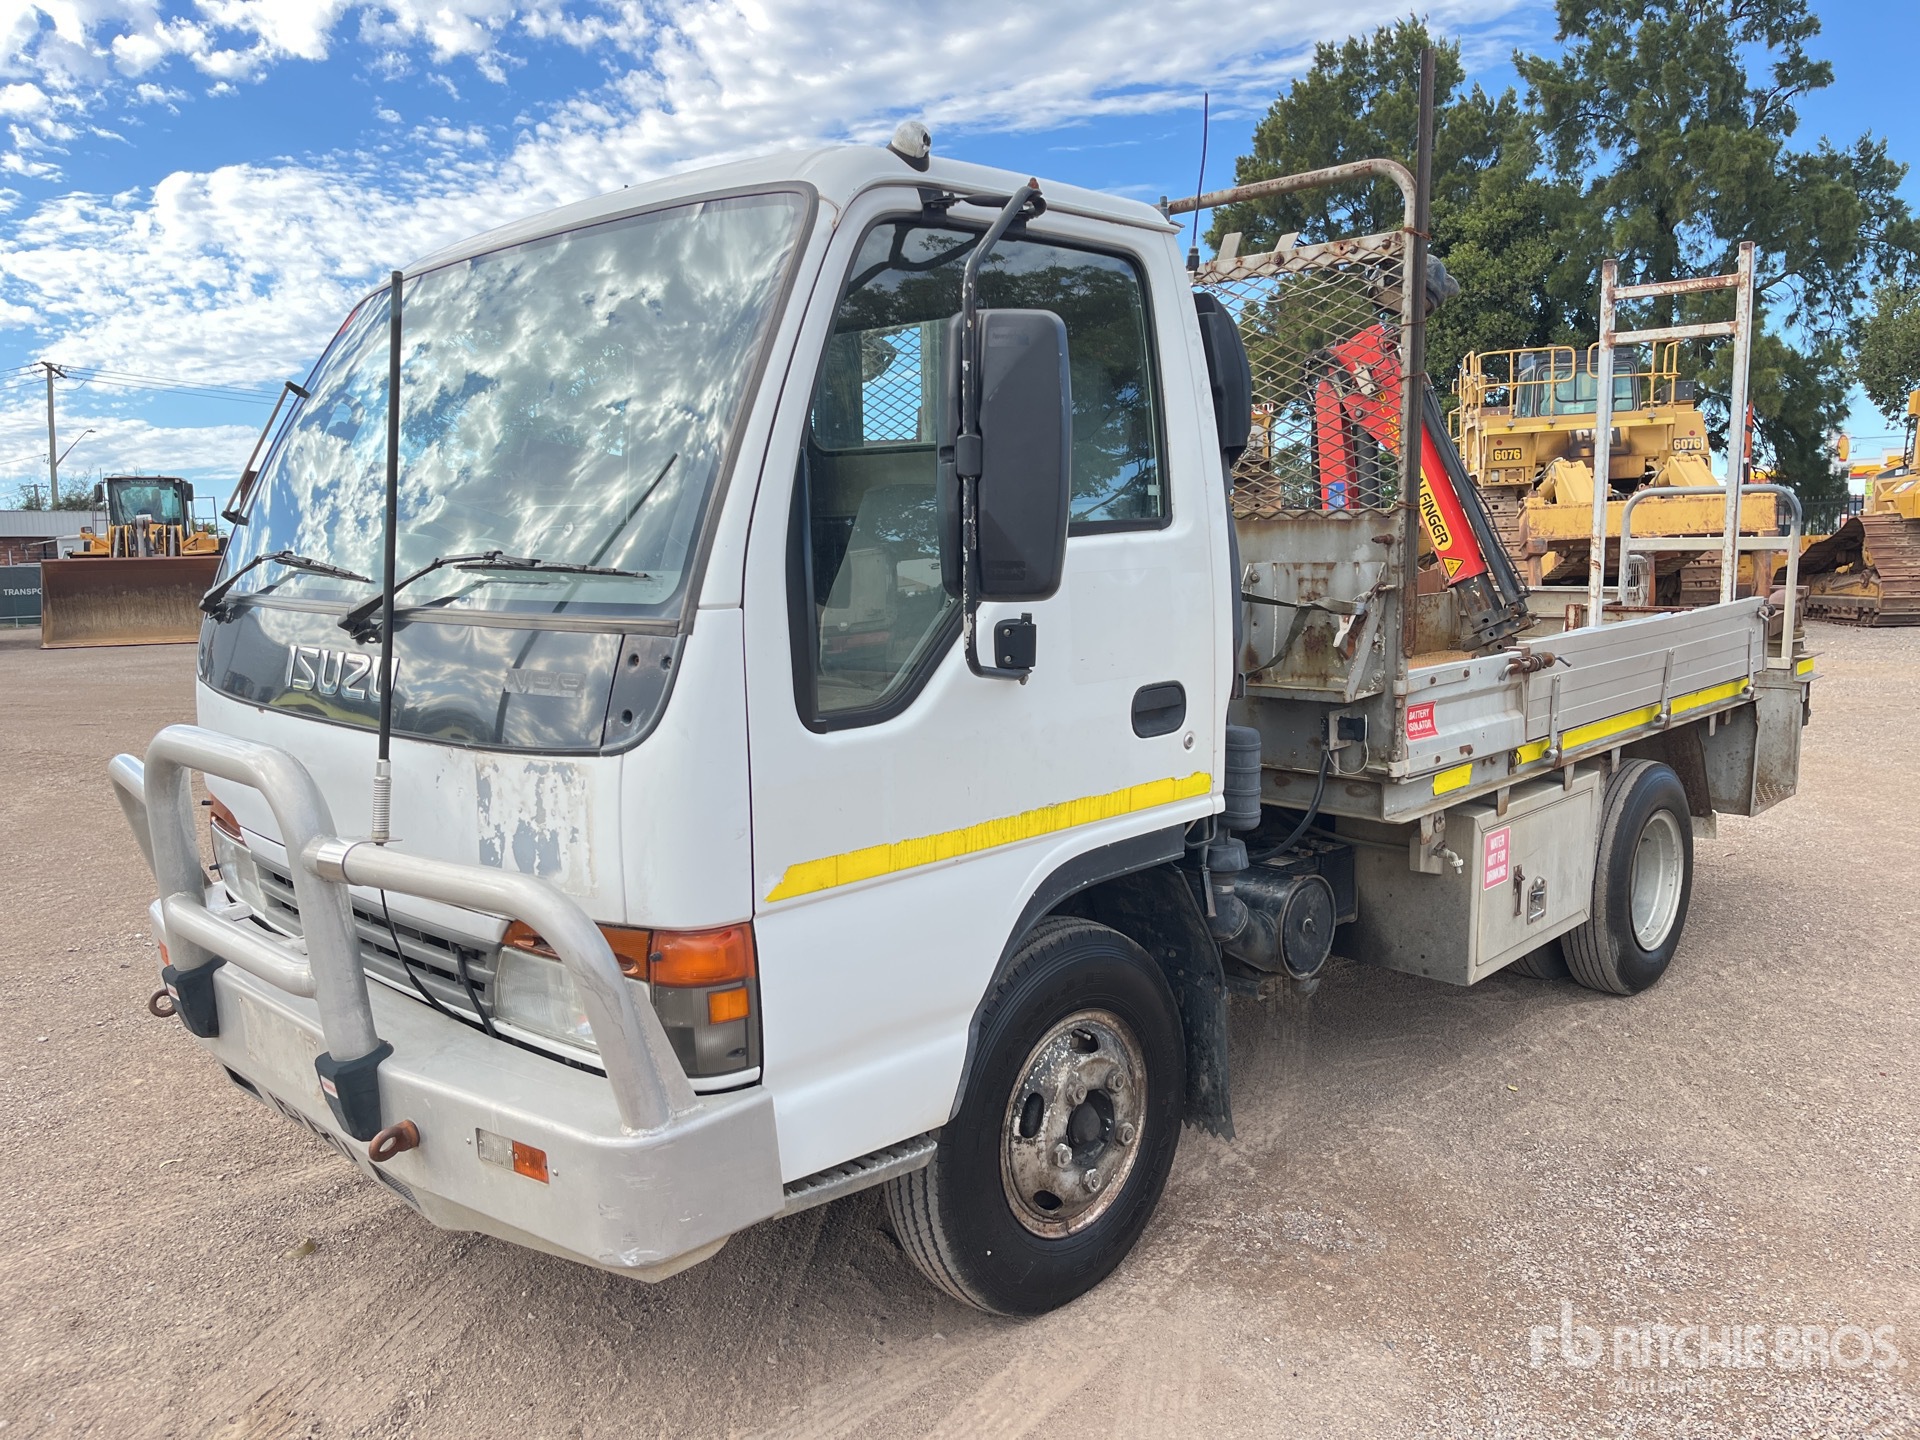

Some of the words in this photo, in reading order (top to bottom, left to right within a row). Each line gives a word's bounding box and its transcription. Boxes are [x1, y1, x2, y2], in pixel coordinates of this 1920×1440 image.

[1673, 438, 1701, 450] 6076
[1494, 449, 1521, 461] 6076
[285, 645, 400, 703] ISUZU
[1409, 708, 1430, 720] BATTERY
[1408, 719, 1433, 732] ISOLATOR
